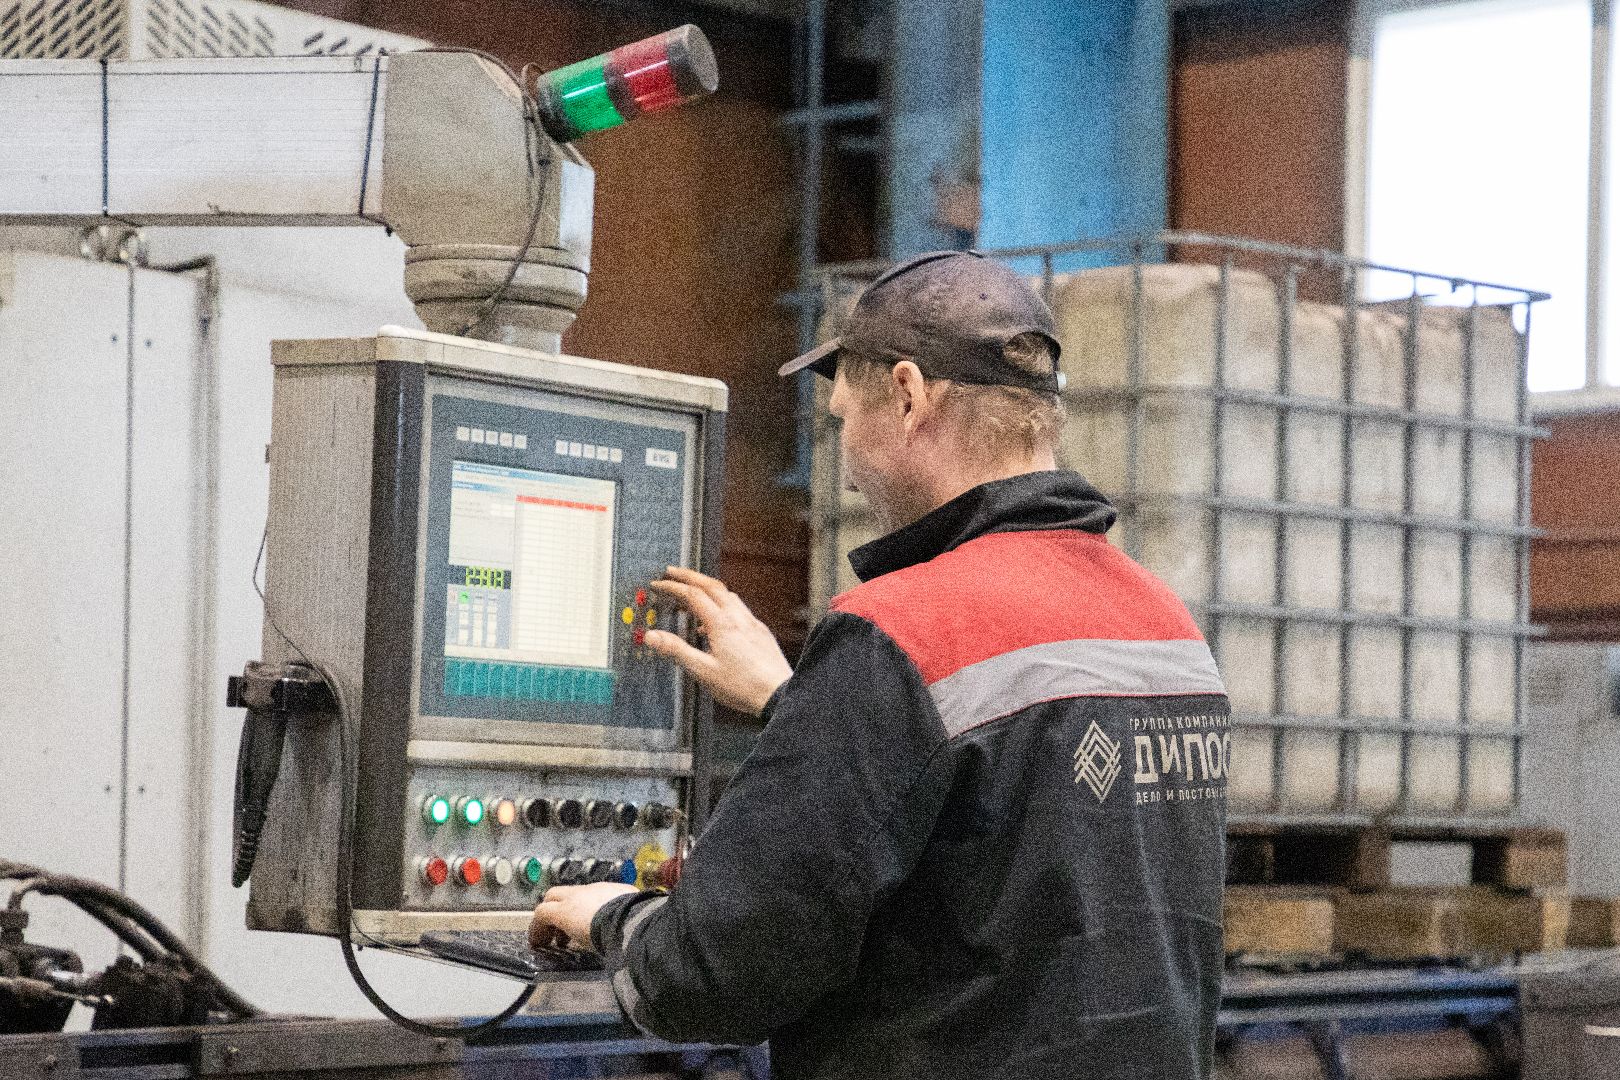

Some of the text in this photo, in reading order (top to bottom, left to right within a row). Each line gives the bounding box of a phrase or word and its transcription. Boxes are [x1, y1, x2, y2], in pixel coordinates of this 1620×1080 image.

[1129, 715, 1231, 731] ГРУППА КОМПАНИ
[1136, 791, 1161, 806] ДЕЛО
[1166, 789, 1174, 801] И
